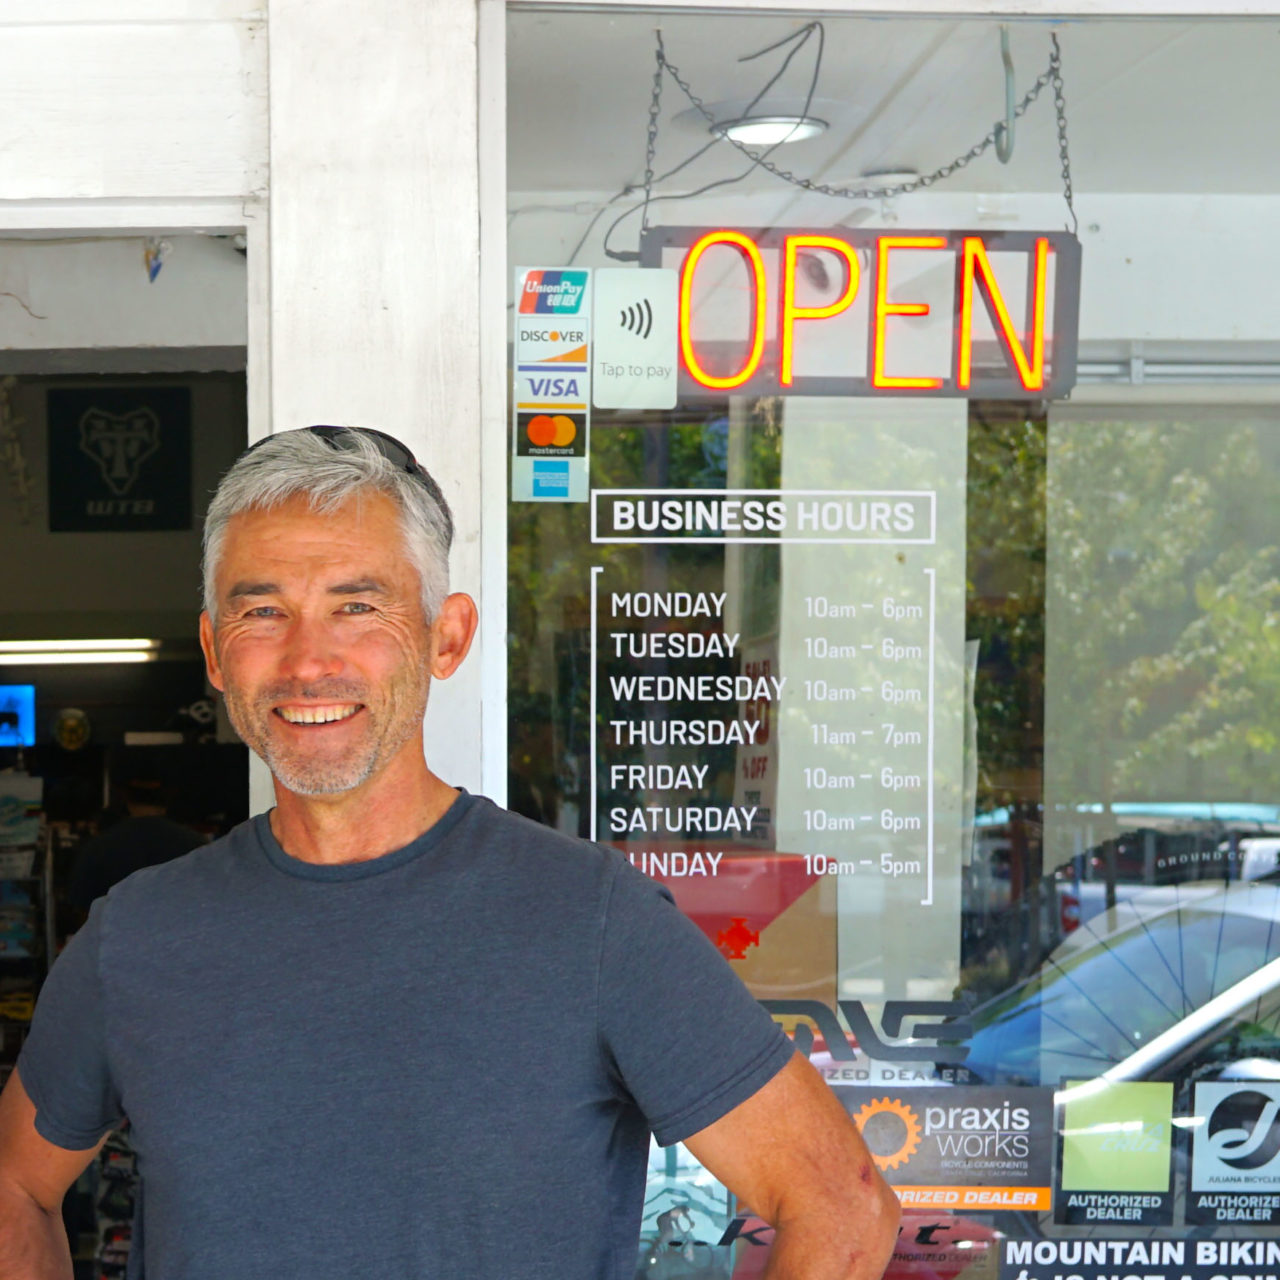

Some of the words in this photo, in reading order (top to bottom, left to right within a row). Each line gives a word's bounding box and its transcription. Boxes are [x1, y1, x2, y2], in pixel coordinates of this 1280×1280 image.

[525, 281, 583, 298] UnionPay
[678, 230, 1048, 390] OPEN
[520, 330, 584, 343] DISCOVER
[600, 363, 621, 378] Tap
[628, 364, 643, 375] to
[647, 366, 671, 381] pay
[525, 378, 580, 397] VISA
[528, 447, 574, 455] mastercard
[612, 500, 787, 532] BUSINESS
[797, 501, 915, 532] HOURS
[610, 592, 728, 618] MONDAY
[804, 596, 856, 618] 10am
[881, 596, 922, 620] 6pm
[610, 632, 741, 659] TUESDAY
[804, 637, 856, 659] 10am
[881, 637, 922, 662] 6pm
[610, 676, 787, 702] WEDNESDAY
[804, 680, 856, 702] 10am
[881, 680, 922, 705] 6pm
[610, 720, 761, 746] THURSDAY
[810, 723, 856, 745] 11am
[881, 723, 922, 748] 7pm
[610, 764, 710, 790] FRIDAY
[803, 767, 856, 789] 10am
[880, 767, 922, 791] 6pm
[610, 806, 758, 833] SATURDAY
[803, 809, 856, 831] 10am
[880, 809, 922, 833] 6pm
[629, 852, 724, 878] UNDAY
[803, 853, 856, 875] 10am
[880, 853, 922, 877] 5pm
[881, 1068, 970, 1082] DEALER
[924, 1101, 1031, 1136] praxis
[936, 1130, 1029, 1158] works
[1208, 1175, 1242, 1184] JULIANA
[963, 1191, 1038, 1205] DEALER
[1068, 1194, 1162, 1208] AUTHORIZED
[1198, 1195, 1280, 1209] AUTHORIZE
[1086, 1207, 1143, 1220] DEALER
[1216, 1208, 1272, 1221] DEALER
[1006, 1241, 1185, 1265] MOUNTAIN
[1196, 1241, 1280, 1266] BIKIN
